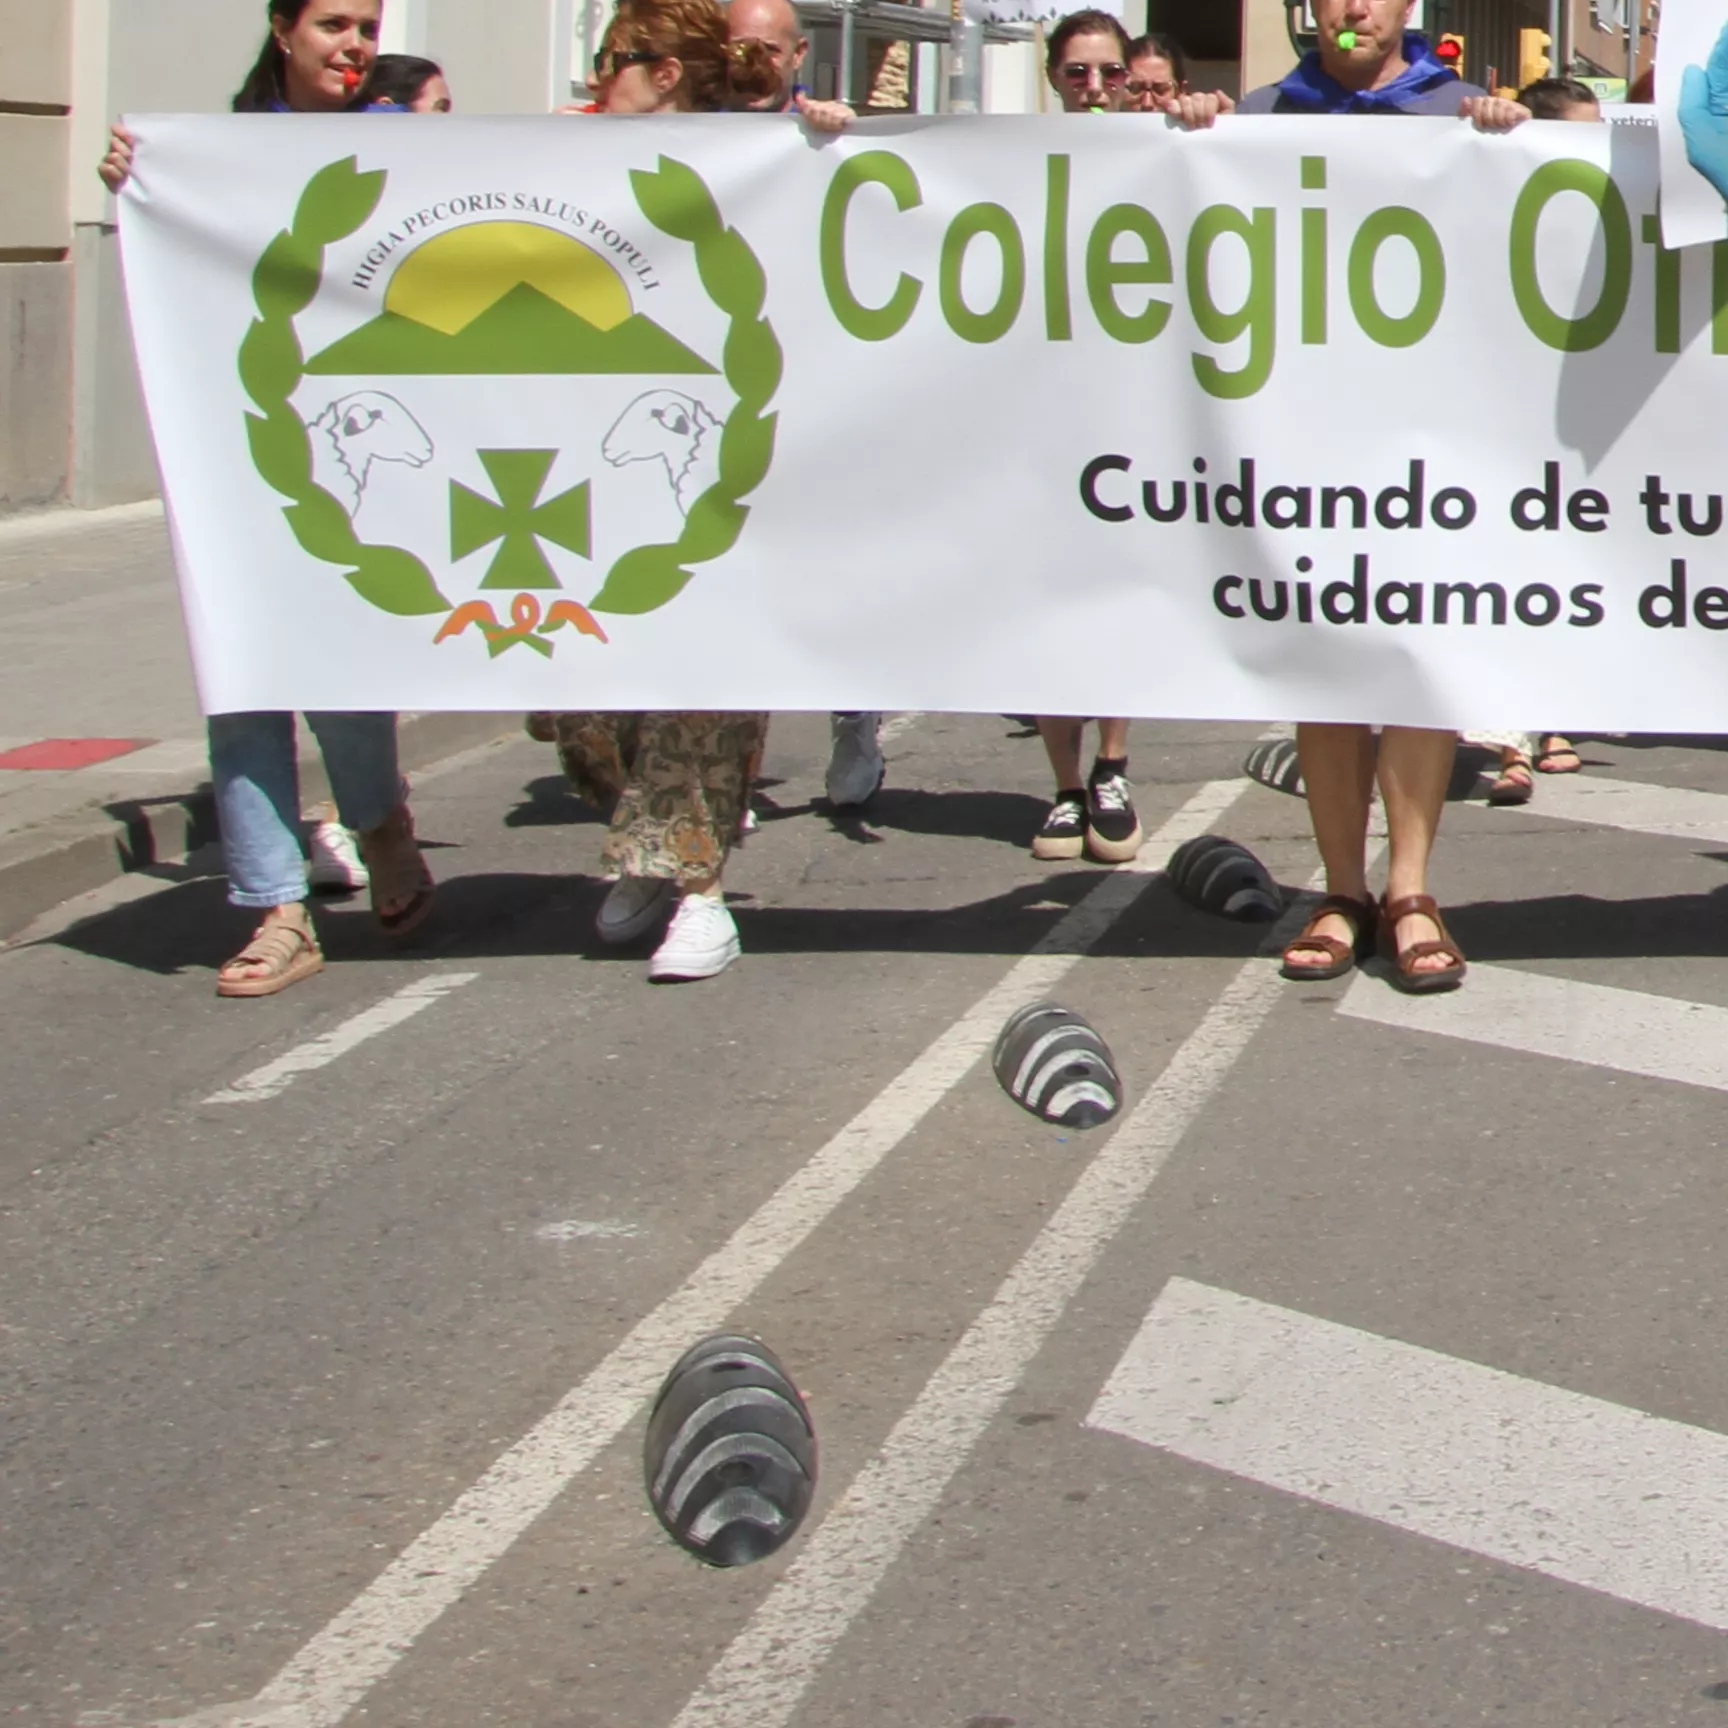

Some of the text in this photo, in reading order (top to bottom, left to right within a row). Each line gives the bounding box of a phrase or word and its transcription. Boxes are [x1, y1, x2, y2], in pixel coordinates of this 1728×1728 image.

[351, 193, 660, 291] HIGIA PECORIS SALUS POPULI
[820, 149, 1446, 399] Colegio
[1079, 454, 1477, 530] Cuidando
[1509, 461, 1611, 533] de
[1640, 475, 1724, 536] tu
[1212, 554, 1605, 627] cuidamos
